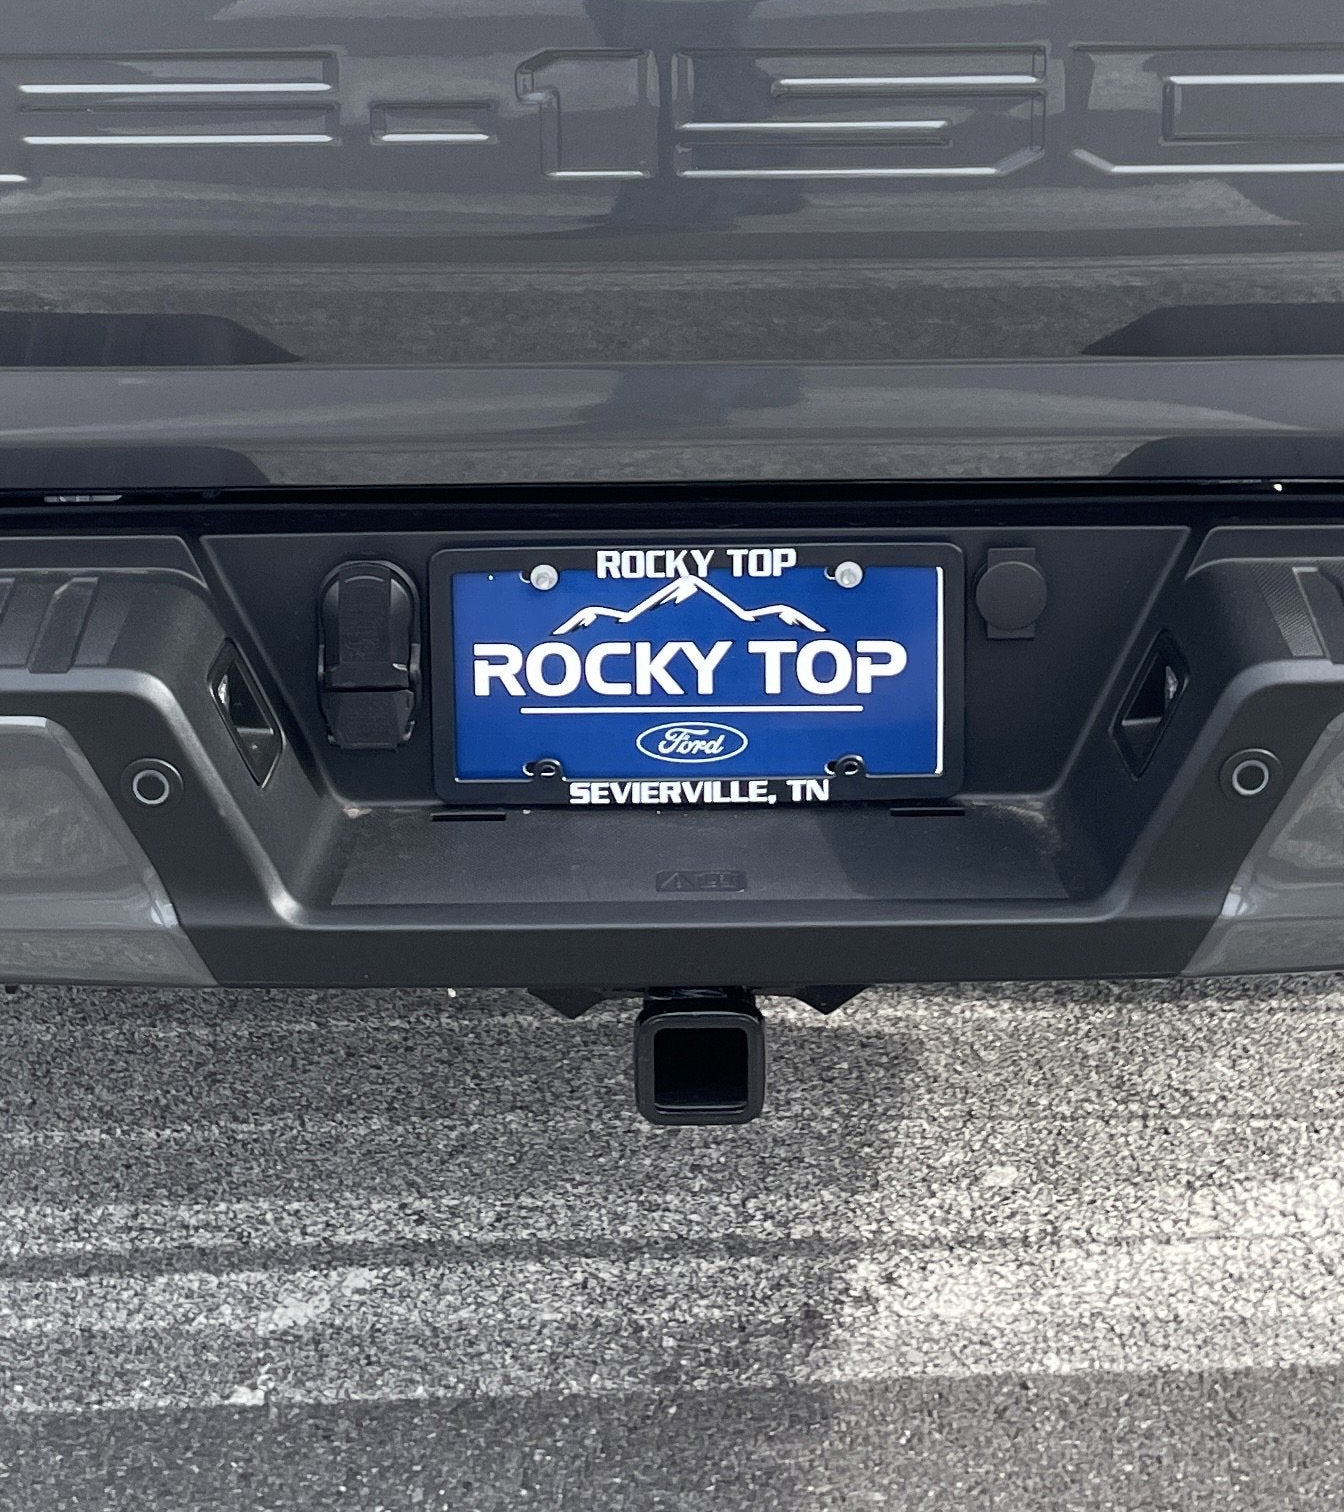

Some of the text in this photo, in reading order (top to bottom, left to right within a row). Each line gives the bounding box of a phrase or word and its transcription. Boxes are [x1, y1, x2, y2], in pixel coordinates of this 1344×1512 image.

[597, 548, 797, 579] ROCKY TOP
[473, 639, 908, 696] ROCKY TOP
[658, 727, 725, 755] Ford
[569, 778, 830, 805] SEVIERVILLE, TN
